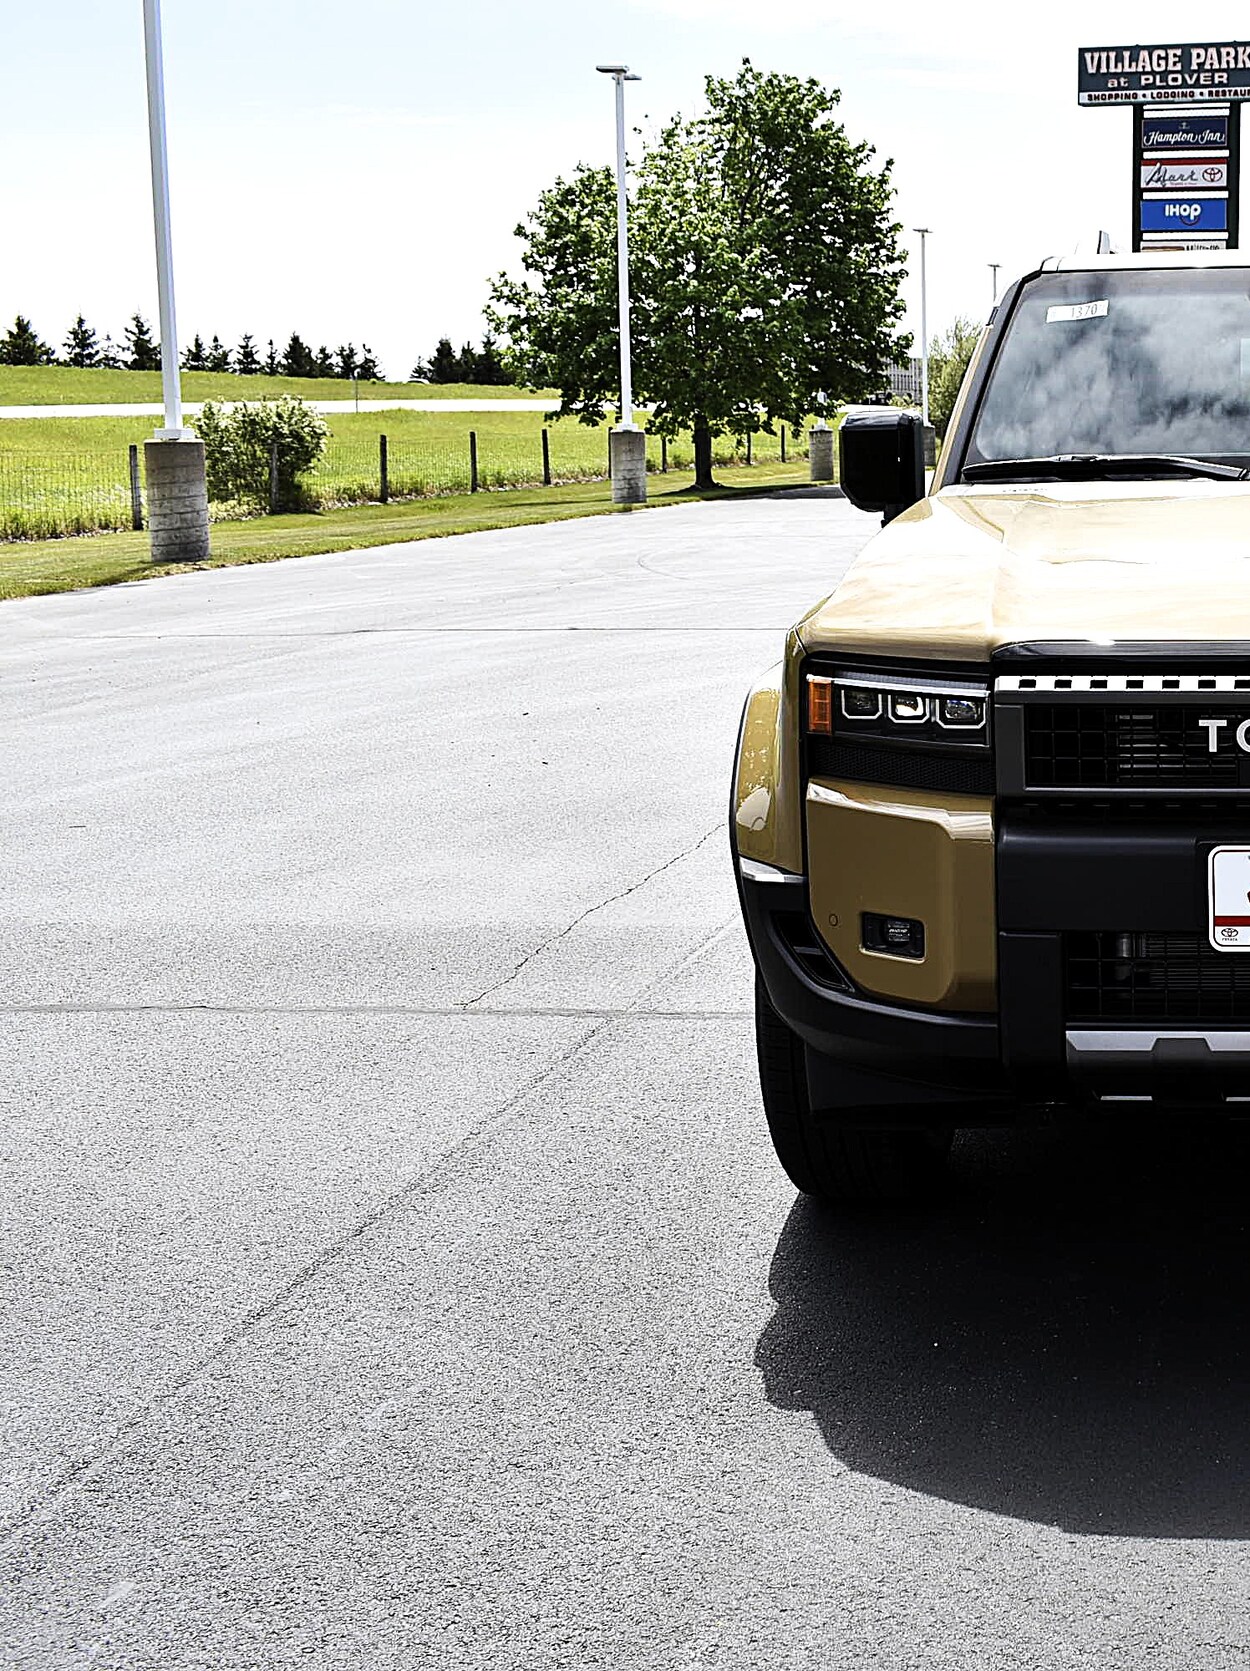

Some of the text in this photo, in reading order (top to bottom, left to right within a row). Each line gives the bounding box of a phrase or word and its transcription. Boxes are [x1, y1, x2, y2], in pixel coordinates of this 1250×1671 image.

[1084, 48, 1183, 74] VILLAGE
[1107, 72, 1229, 88] at PLOVER
[1087, 92, 1138, 101] SHOPPING
[1150, 90, 1196, 100] LODGING
[1143, 129, 1225, 146] Hampton Inn
